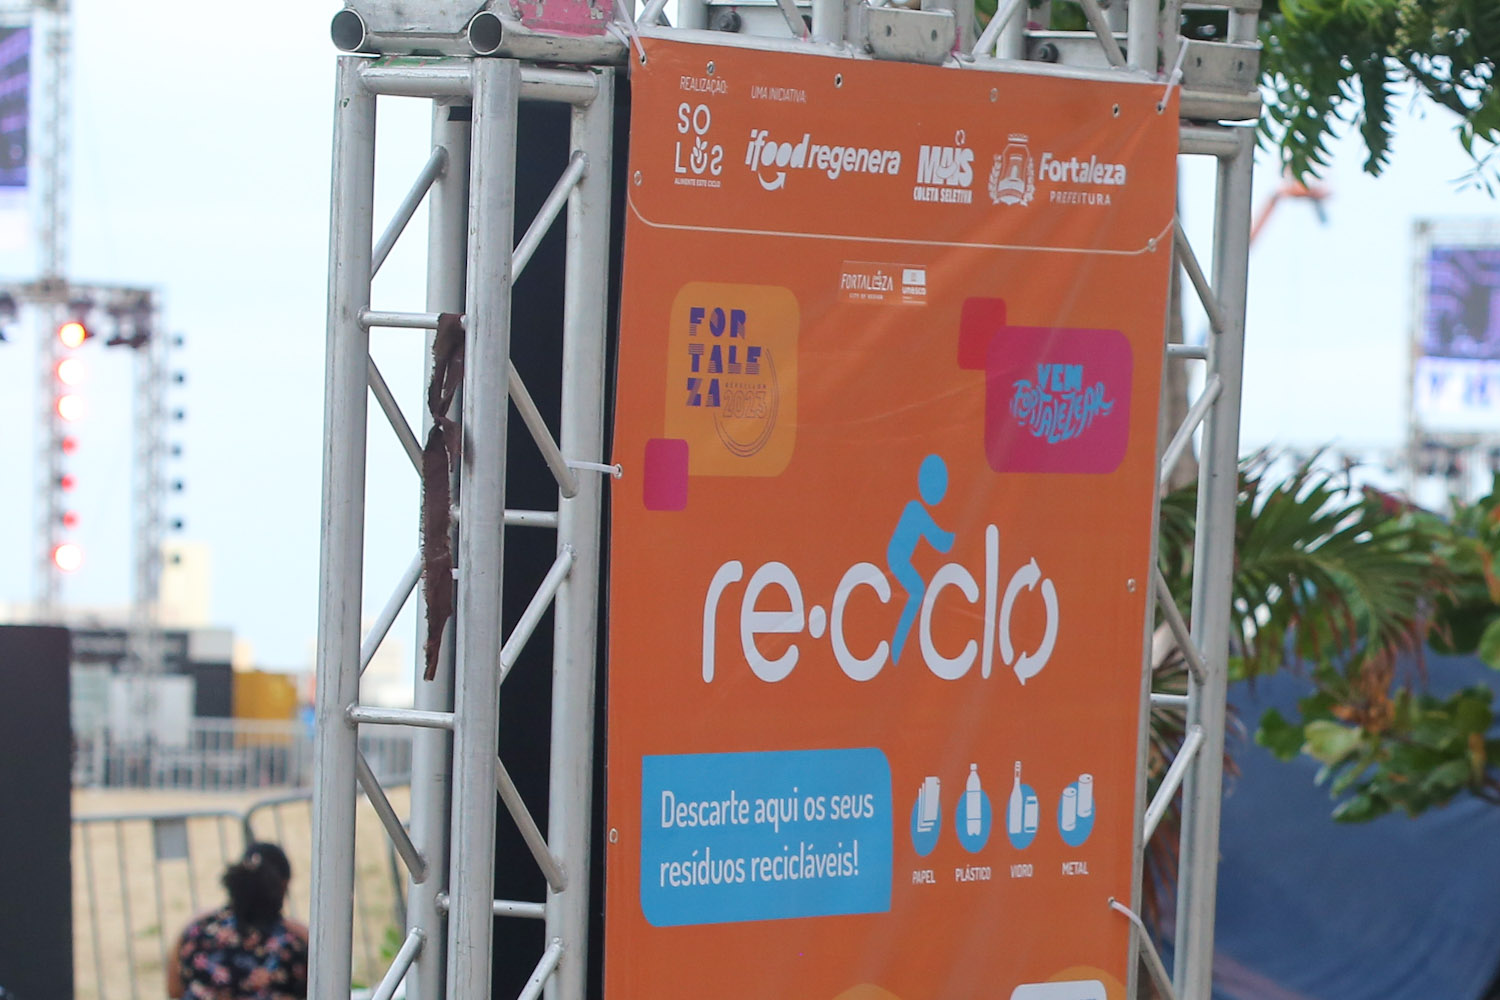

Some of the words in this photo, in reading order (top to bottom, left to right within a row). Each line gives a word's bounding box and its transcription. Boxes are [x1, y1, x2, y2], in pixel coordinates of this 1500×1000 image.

[680, 76, 728, 96] REALIZAÇÃO:
[752, 86, 768, 99] UMA
[769, 88, 807, 102] INICIATIVA:
[677, 102, 711, 136] SO
[808, 144, 901, 180] regenera
[917, 145, 975, 188] MAIS
[1039, 152, 1127, 185] Fortaleza
[913, 186, 939, 202] COLETA
[940, 187, 973, 204] SELETIVA
[1050, 190, 1112, 206] PREFEITURA
[1037, 363, 1084, 392] VEM
[723, 390, 768, 419] 2023
[661, 789, 750, 829] Descarte
[754, 786, 799, 833] aqui
[803, 796, 826, 821] os
[830, 793, 874, 820] seus
[660, 846, 746, 888] resíduos
[751, 839, 860, 882] recicláveis!
[955, 864, 992, 882] PLÁSTICO
[1010, 863, 1034, 879] VIDRO
[1062, 861, 1089, 876] METAL
[912, 870, 936, 885] PAPEL
